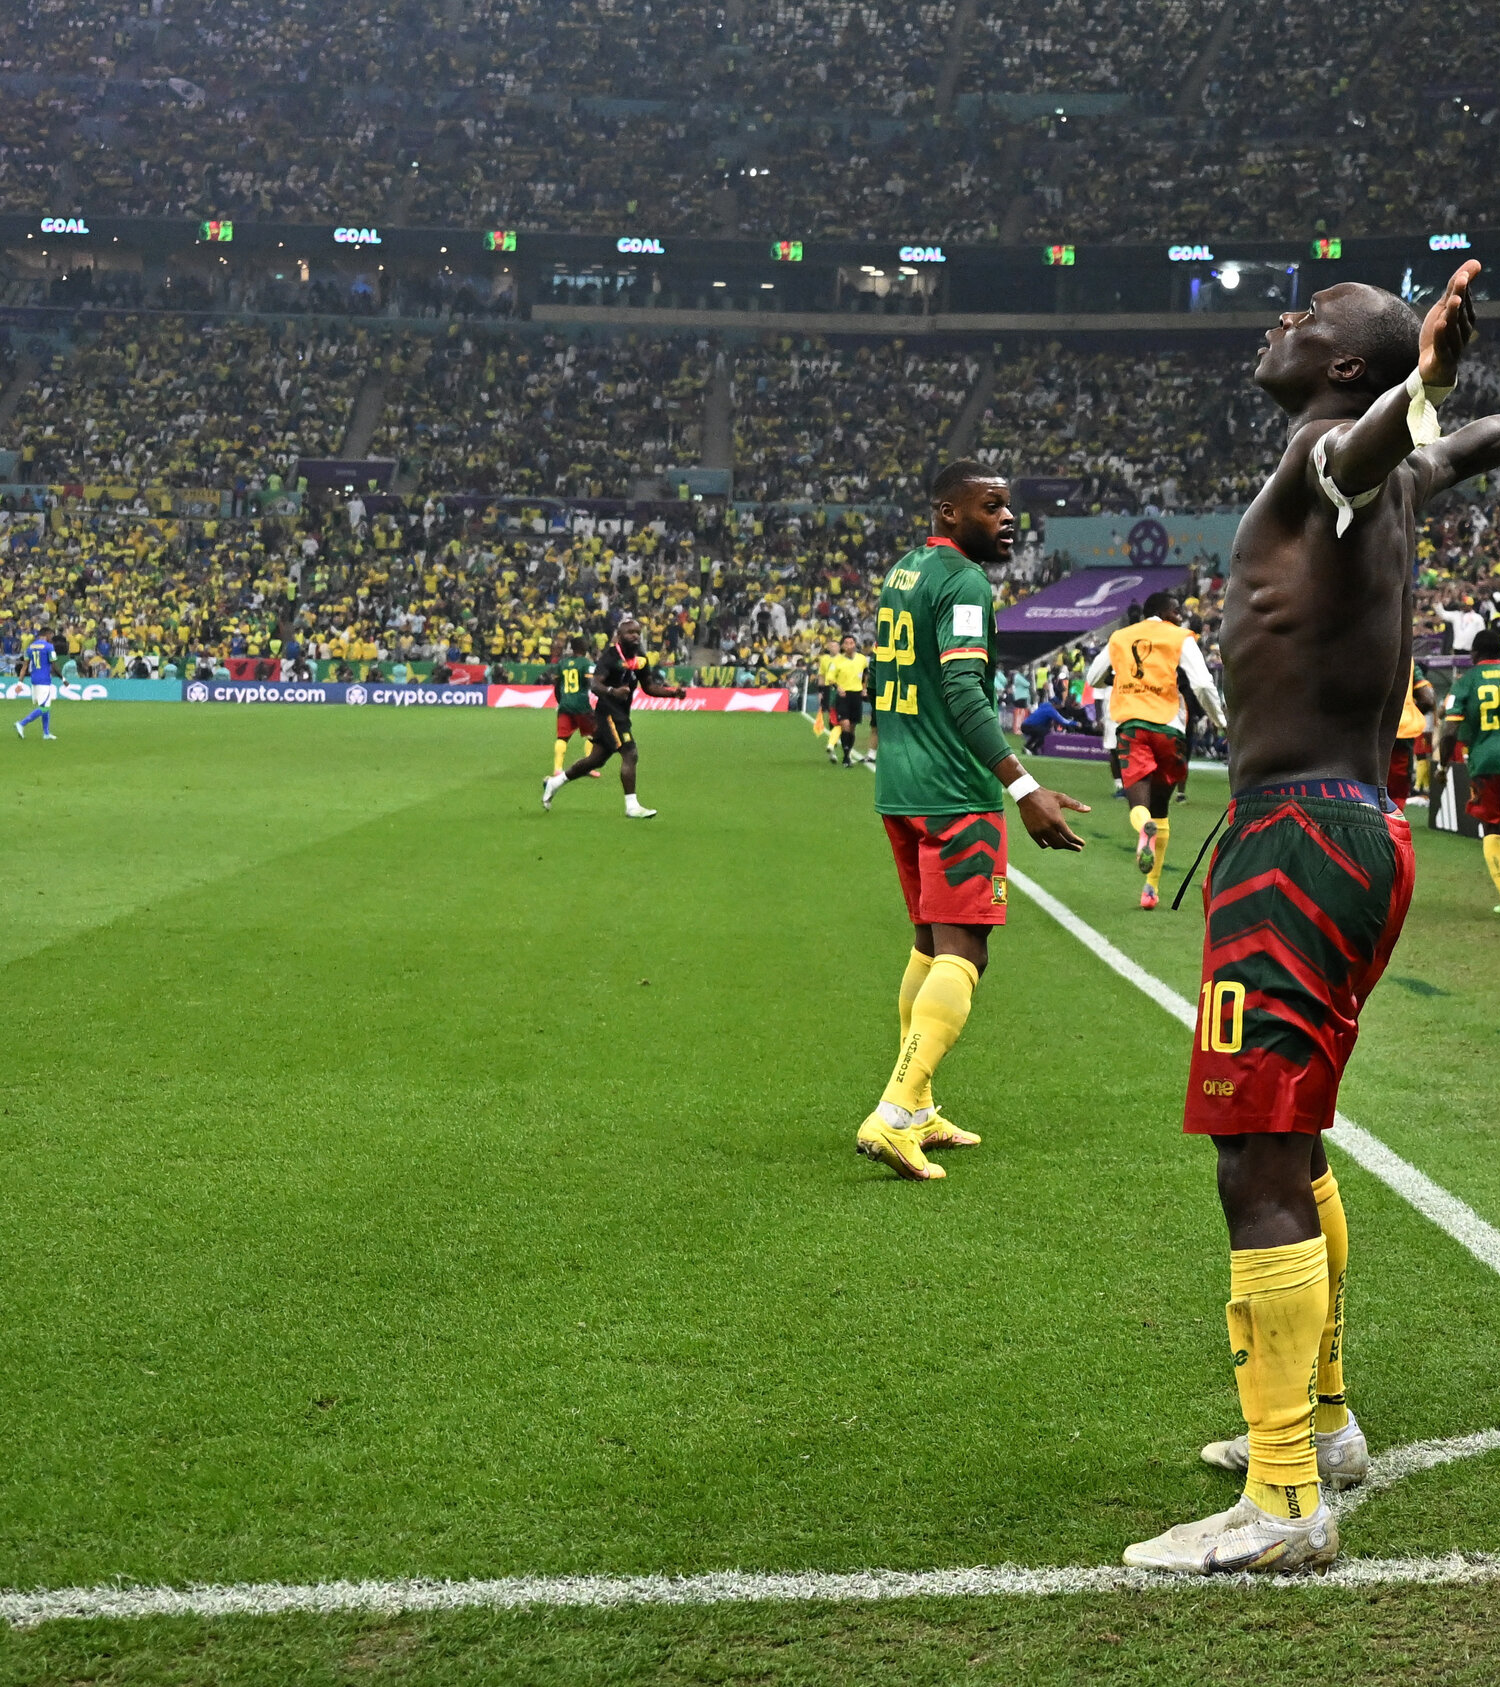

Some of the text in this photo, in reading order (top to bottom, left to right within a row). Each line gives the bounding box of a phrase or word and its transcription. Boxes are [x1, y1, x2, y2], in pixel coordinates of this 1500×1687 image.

[41, 217, 89, 235] GOAL
[334, 227, 381, 244] GOAL
[1429, 233, 1471, 251] GOAL
[617, 237, 665, 254] GOAL
[900, 246, 946, 263] GOAL
[1168, 245, 1214, 261] GOAL
[32, 651, 41, 669] 11
[876, 607, 918, 715] 22
[562, 668, 579, 693] 19
[214, 685, 326, 704] crypto.com
[373, 687, 484, 706] crypto.com
[1201, 980, 1246, 1054] 10
[896, 1033, 922, 1083] CAMEROUN
[1203, 1079, 1236, 1097] one
[1328, 1269, 1347, 1364] CAMEROUN
